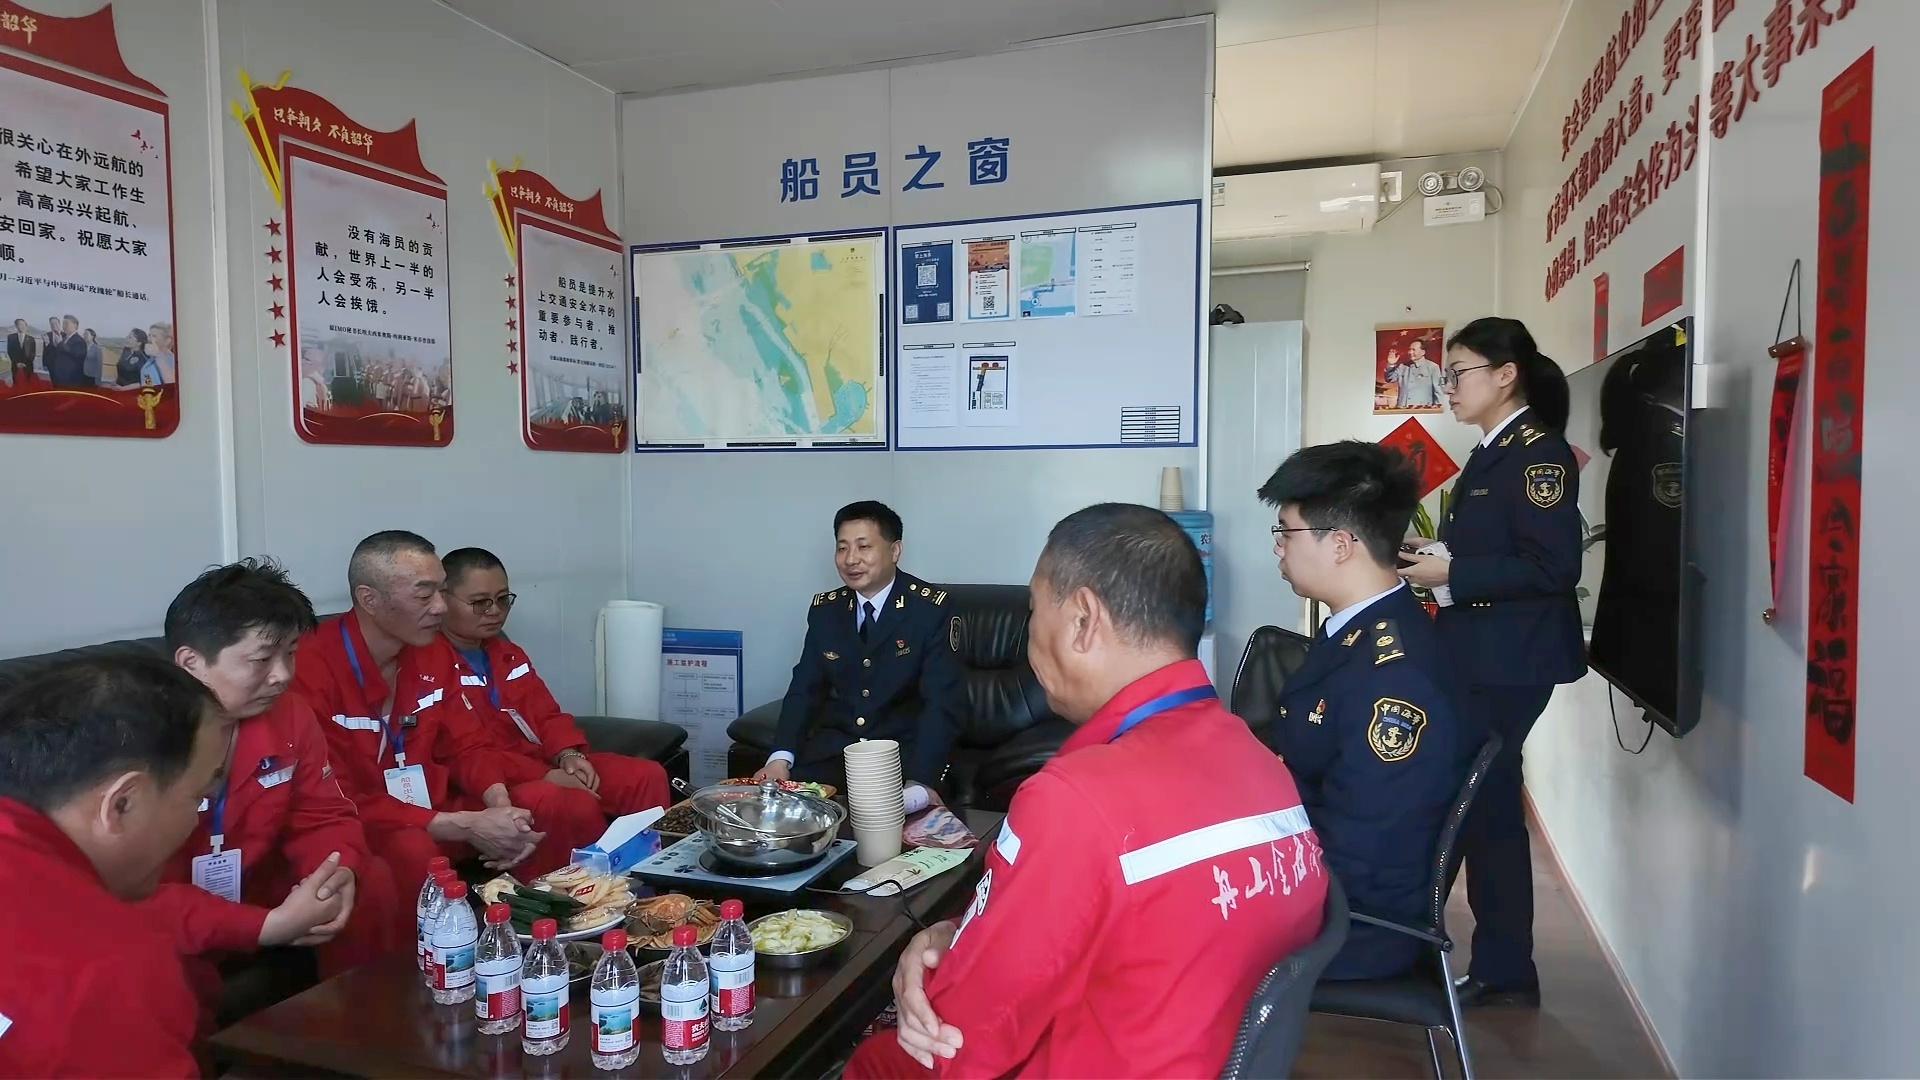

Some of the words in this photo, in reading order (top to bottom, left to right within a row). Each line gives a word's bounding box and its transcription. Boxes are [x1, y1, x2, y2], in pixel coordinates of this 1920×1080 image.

[1561, 0, 1665, 162] 安全是民航业的
[273, 107, 322, 133] 只争朝夕
[327, 124, 373, 156] 不负韶华
[0, 127, 144, 178] 很关心在外远航的
[1545, 0, 1856, 302] 心的思想，始终把安全作为头等大事来
[14, 160, 146, 204] 希望大家工作生
[780, 137, 1010, 204] 船员之窗
[510, 185, 541, 204] 只争朝夕
[544, 196, 574, 220] 不负韶华
[0, 214, 148, 257] 安回家。祝愿大家
[348, 225, 433, 257] 没有海员的贡
[315, 241, 434, 279] 献，世界上一半的
[317, 266, 434, 300] 人会受冻，另一半
[558, 276, 615, 300] 船员是提升水
[318, 291, 386, 315] 人会挨饿。
[537, 290, 615, 318] 上交通安全水平的
[538, 310, 616, 336] 重要参与者、推
[538, 328, 603, 351] 动者、践行者。
[666, 658, 708, 668] 施工监护流程
[1380, 703, 1422, 725] 中国海事
